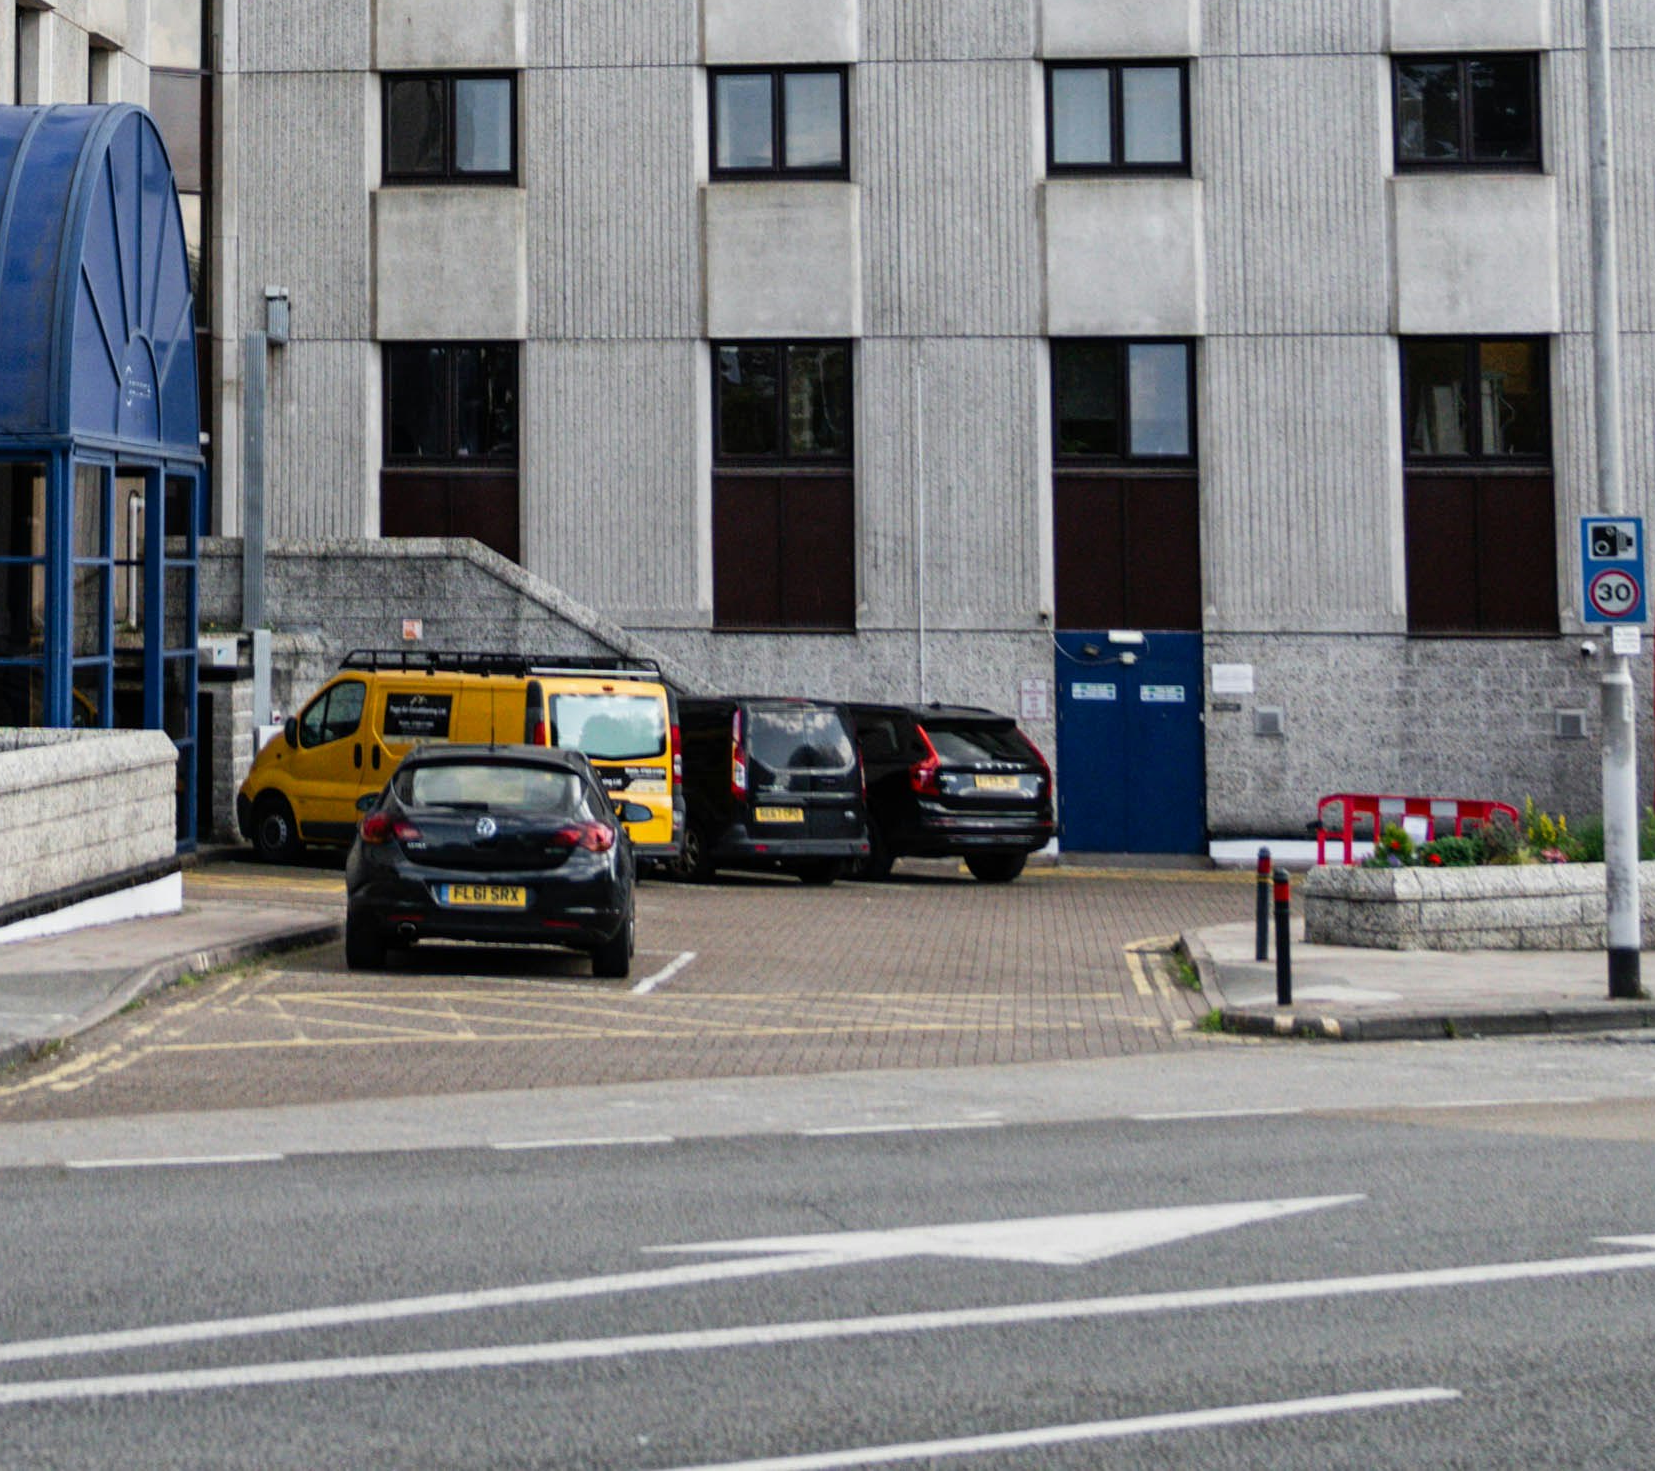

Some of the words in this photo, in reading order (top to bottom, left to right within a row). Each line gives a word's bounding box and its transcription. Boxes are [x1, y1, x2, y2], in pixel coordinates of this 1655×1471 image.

[1597, 582, 1631, 602] 30
[453, 885, 488, 901] FL61
[490, 886, 520, 902] SRX
